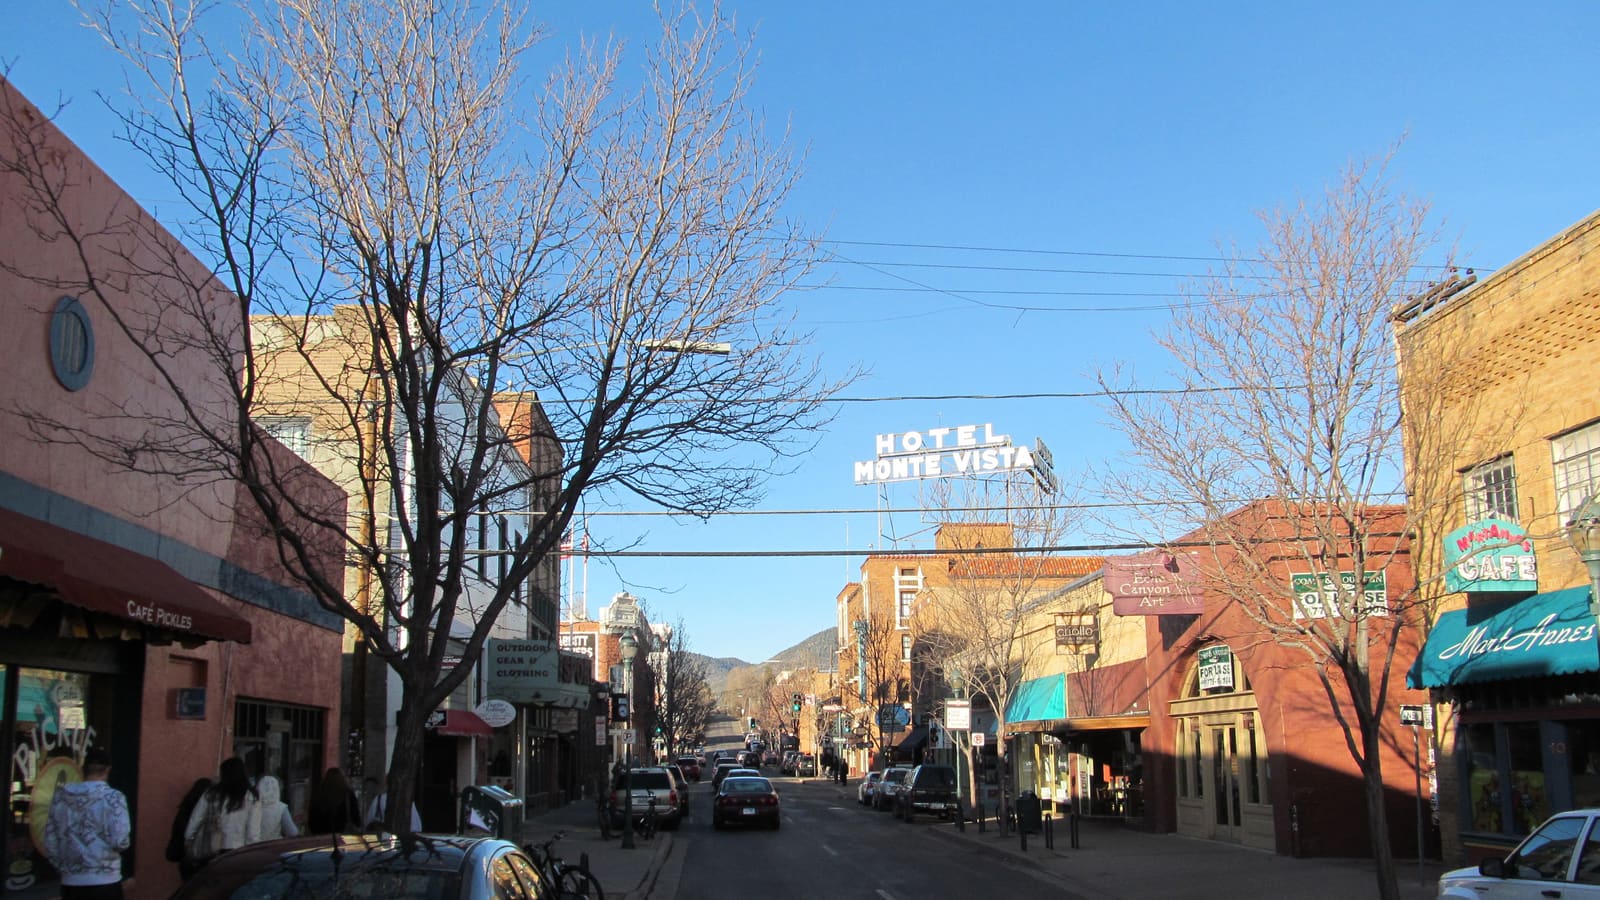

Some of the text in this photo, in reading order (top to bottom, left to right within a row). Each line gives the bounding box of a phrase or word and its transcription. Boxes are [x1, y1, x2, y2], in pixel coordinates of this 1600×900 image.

[876, 423, 1005, 454] HOTEL
[854, 455, 941, 482] MONTE
[953, 446, 1035, 473] VISTA
[1457, 554, 1537, 581] CAFE
[1120, 583, 1170, 596] Canyon
[1139, 597, 1164, 607] Art
[156, 608, 192, 629] PICKLES
[497, 656, 524, 664] GEAR
[496, 669, 549, 677] CLOTHING
[1200, 667, 1213, 677] FOR
